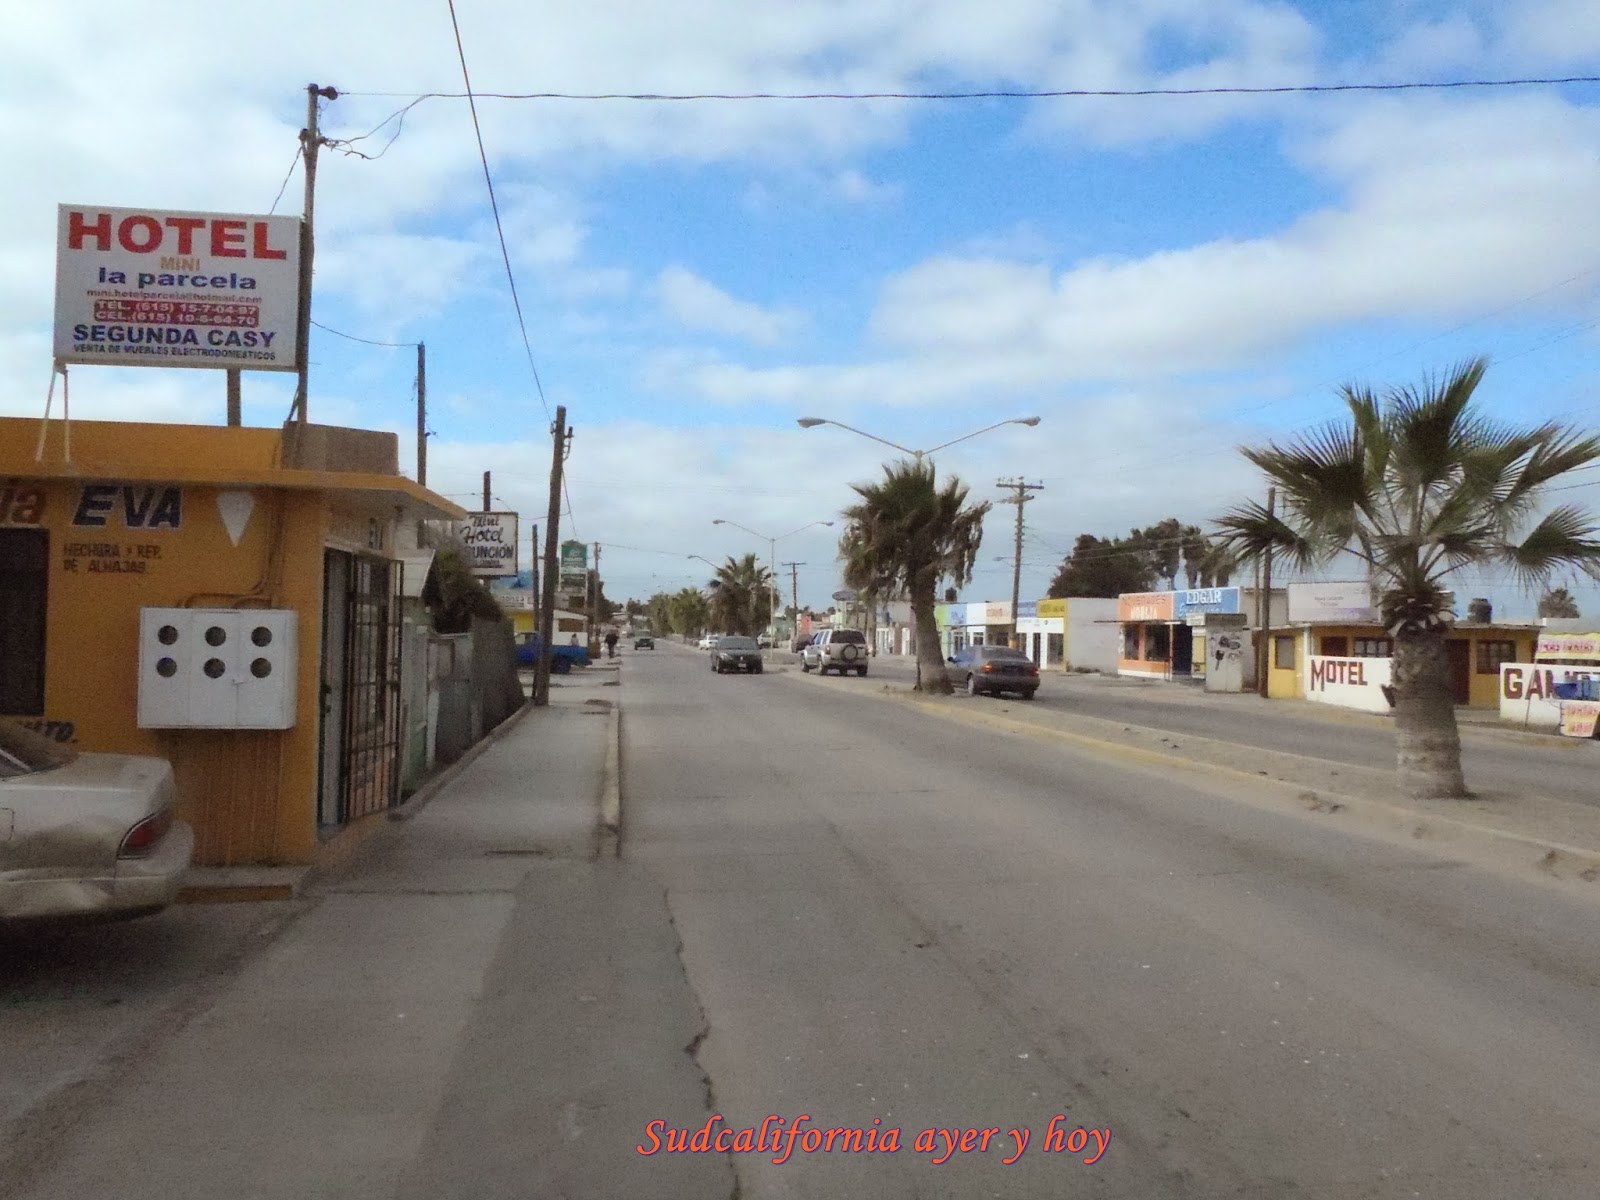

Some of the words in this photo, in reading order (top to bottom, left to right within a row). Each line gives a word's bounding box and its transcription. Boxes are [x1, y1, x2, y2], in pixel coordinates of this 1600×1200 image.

[69, 211, 287, 260] HOTEL
[160, 257, 201, 272] MINI
[99, 267, 126, 284] la
[138, 271, 257, 290] parcela
[98, 300, 131, 312] TEL.
[74, 323, 199, 346] SEGUNDA
[208, 329, 277, 349] CASY
[74, 344, 106, 354] VENTA
[108, 344, 121, 354] DE
[124, 345, 169, 356] MUEBLES
[171, 346, 276, 361] ELECTRODOMESTICOS
[73, 484, 182, 529] EVA
[460, 526, 504, 544] Hotel
[64, 560, 78, 571] DE
[1186, 589, 1222, 604] EDGAR
[1310, 659, 1368, 692] MOTEL
